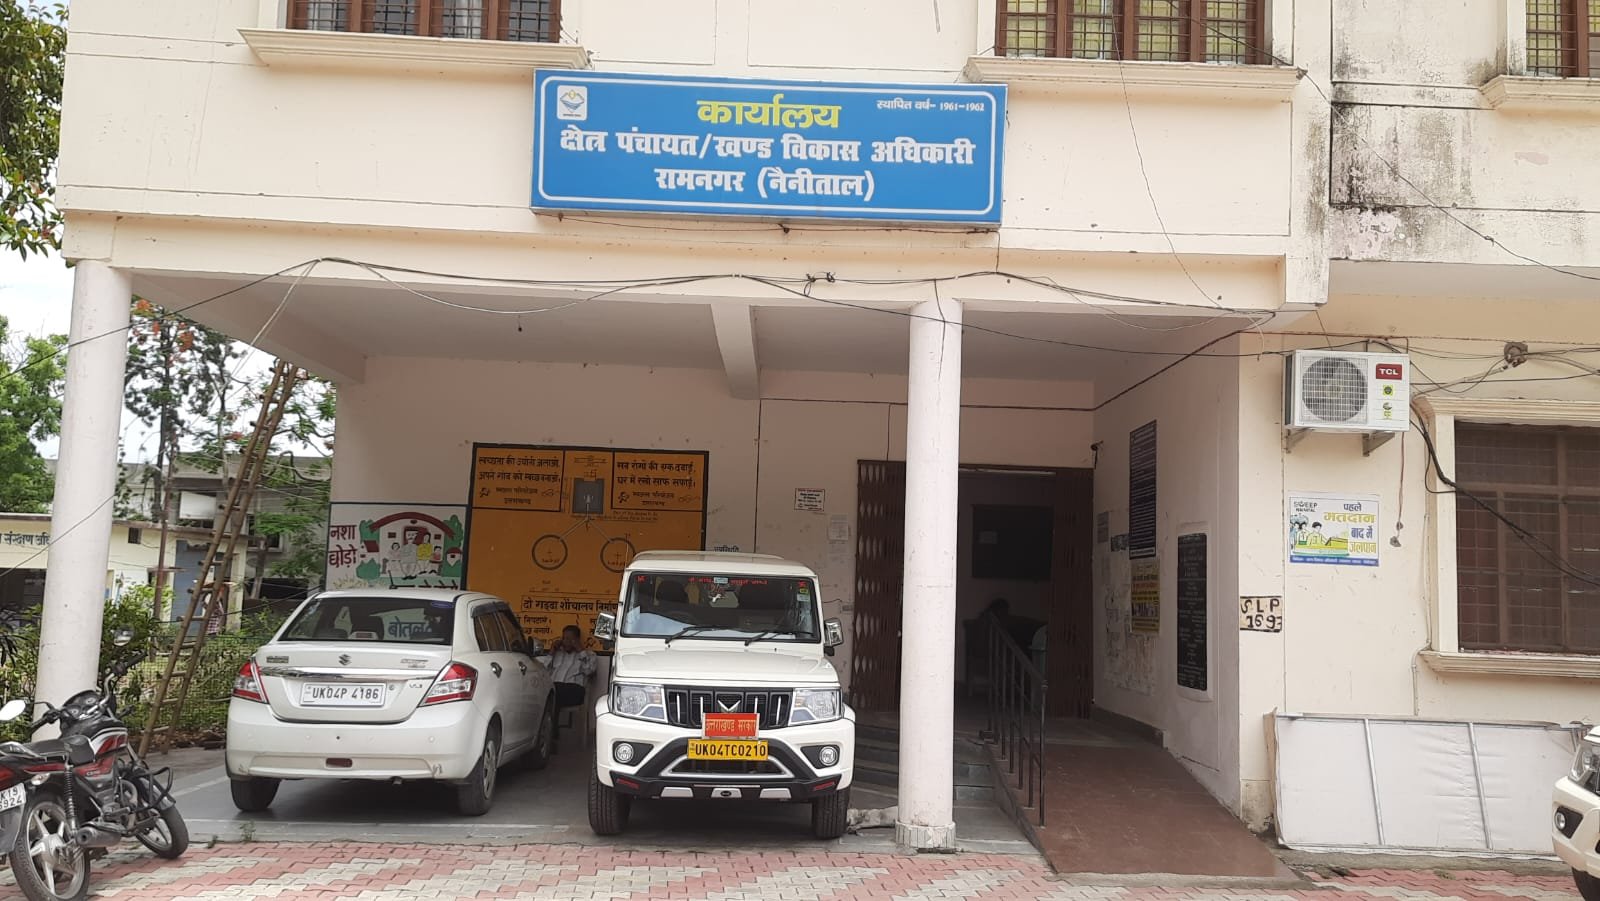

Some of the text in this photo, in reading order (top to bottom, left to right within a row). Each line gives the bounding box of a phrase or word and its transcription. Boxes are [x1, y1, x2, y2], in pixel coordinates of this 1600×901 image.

[877, 97, 911, 111] स्थापित
[939, 101, 984, 112] 1961-1962
[697, 94, 841, 128] कार्यालय
[560, 124, 976, 165] क्षेत्र पंचायत/खण्ड विकास अधिकारी
[654, 167, 876, 201] रामनगर (नैनीताल)
[1379, 368, 1399, 376] TCL
[506, 454, 515, 465] की
[648, 460, 658, 471] की
[512, 469, 523, 481] को
[616, 477, 626, 485] घर
[653, 477, 670, 487] साफ
[1343, 502, 1362, 512] पहले
[1323, 512, 1376, 523] मतदान
[328, 525, 357, 540] नशा
[1351, 527, 1364, 539] बाद
[1349, 542, 1376, 554] जलपान
[523, 598, 532, 609] दो
[312, 686, 379, 700] UK04P 4186
[706, 719, 735, 732] उत्तराखण्ड
[695, 743, 766, 757] UK04TC0210
